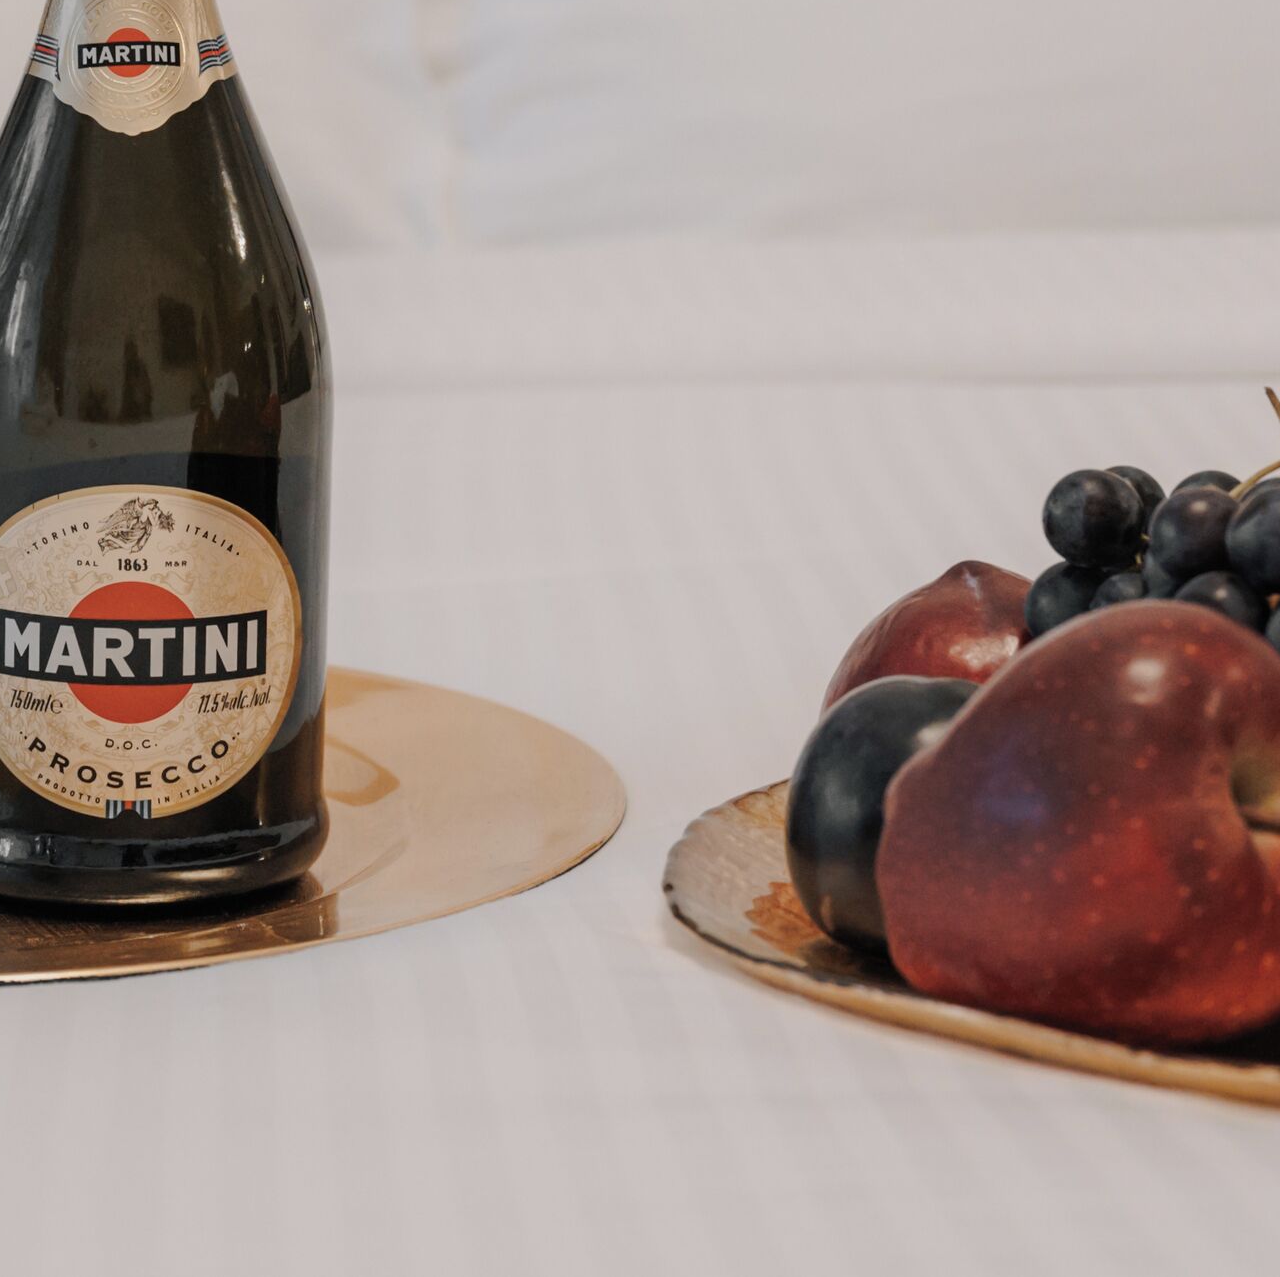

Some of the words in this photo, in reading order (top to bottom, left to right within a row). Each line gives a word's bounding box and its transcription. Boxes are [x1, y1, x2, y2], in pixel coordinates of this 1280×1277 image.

[81, 44, 176, 65] MARTINI
[32, 521, 90, 551] TORINO
[185, 524, 234, 553] ITALIA
[117, 558, 149, 572] 1863
[164, 560, 188, 568] M&R
[4, 617, 259, 678] MARTINI
[105, 738, 158, 751] D.O.C.
[28, 736, 229, 789] PROSECCO
[36, 773, 102, 804] PRODOTTO
[157, 796, 171, 804] IN
[179, 775, 220, 798] ITALIA
